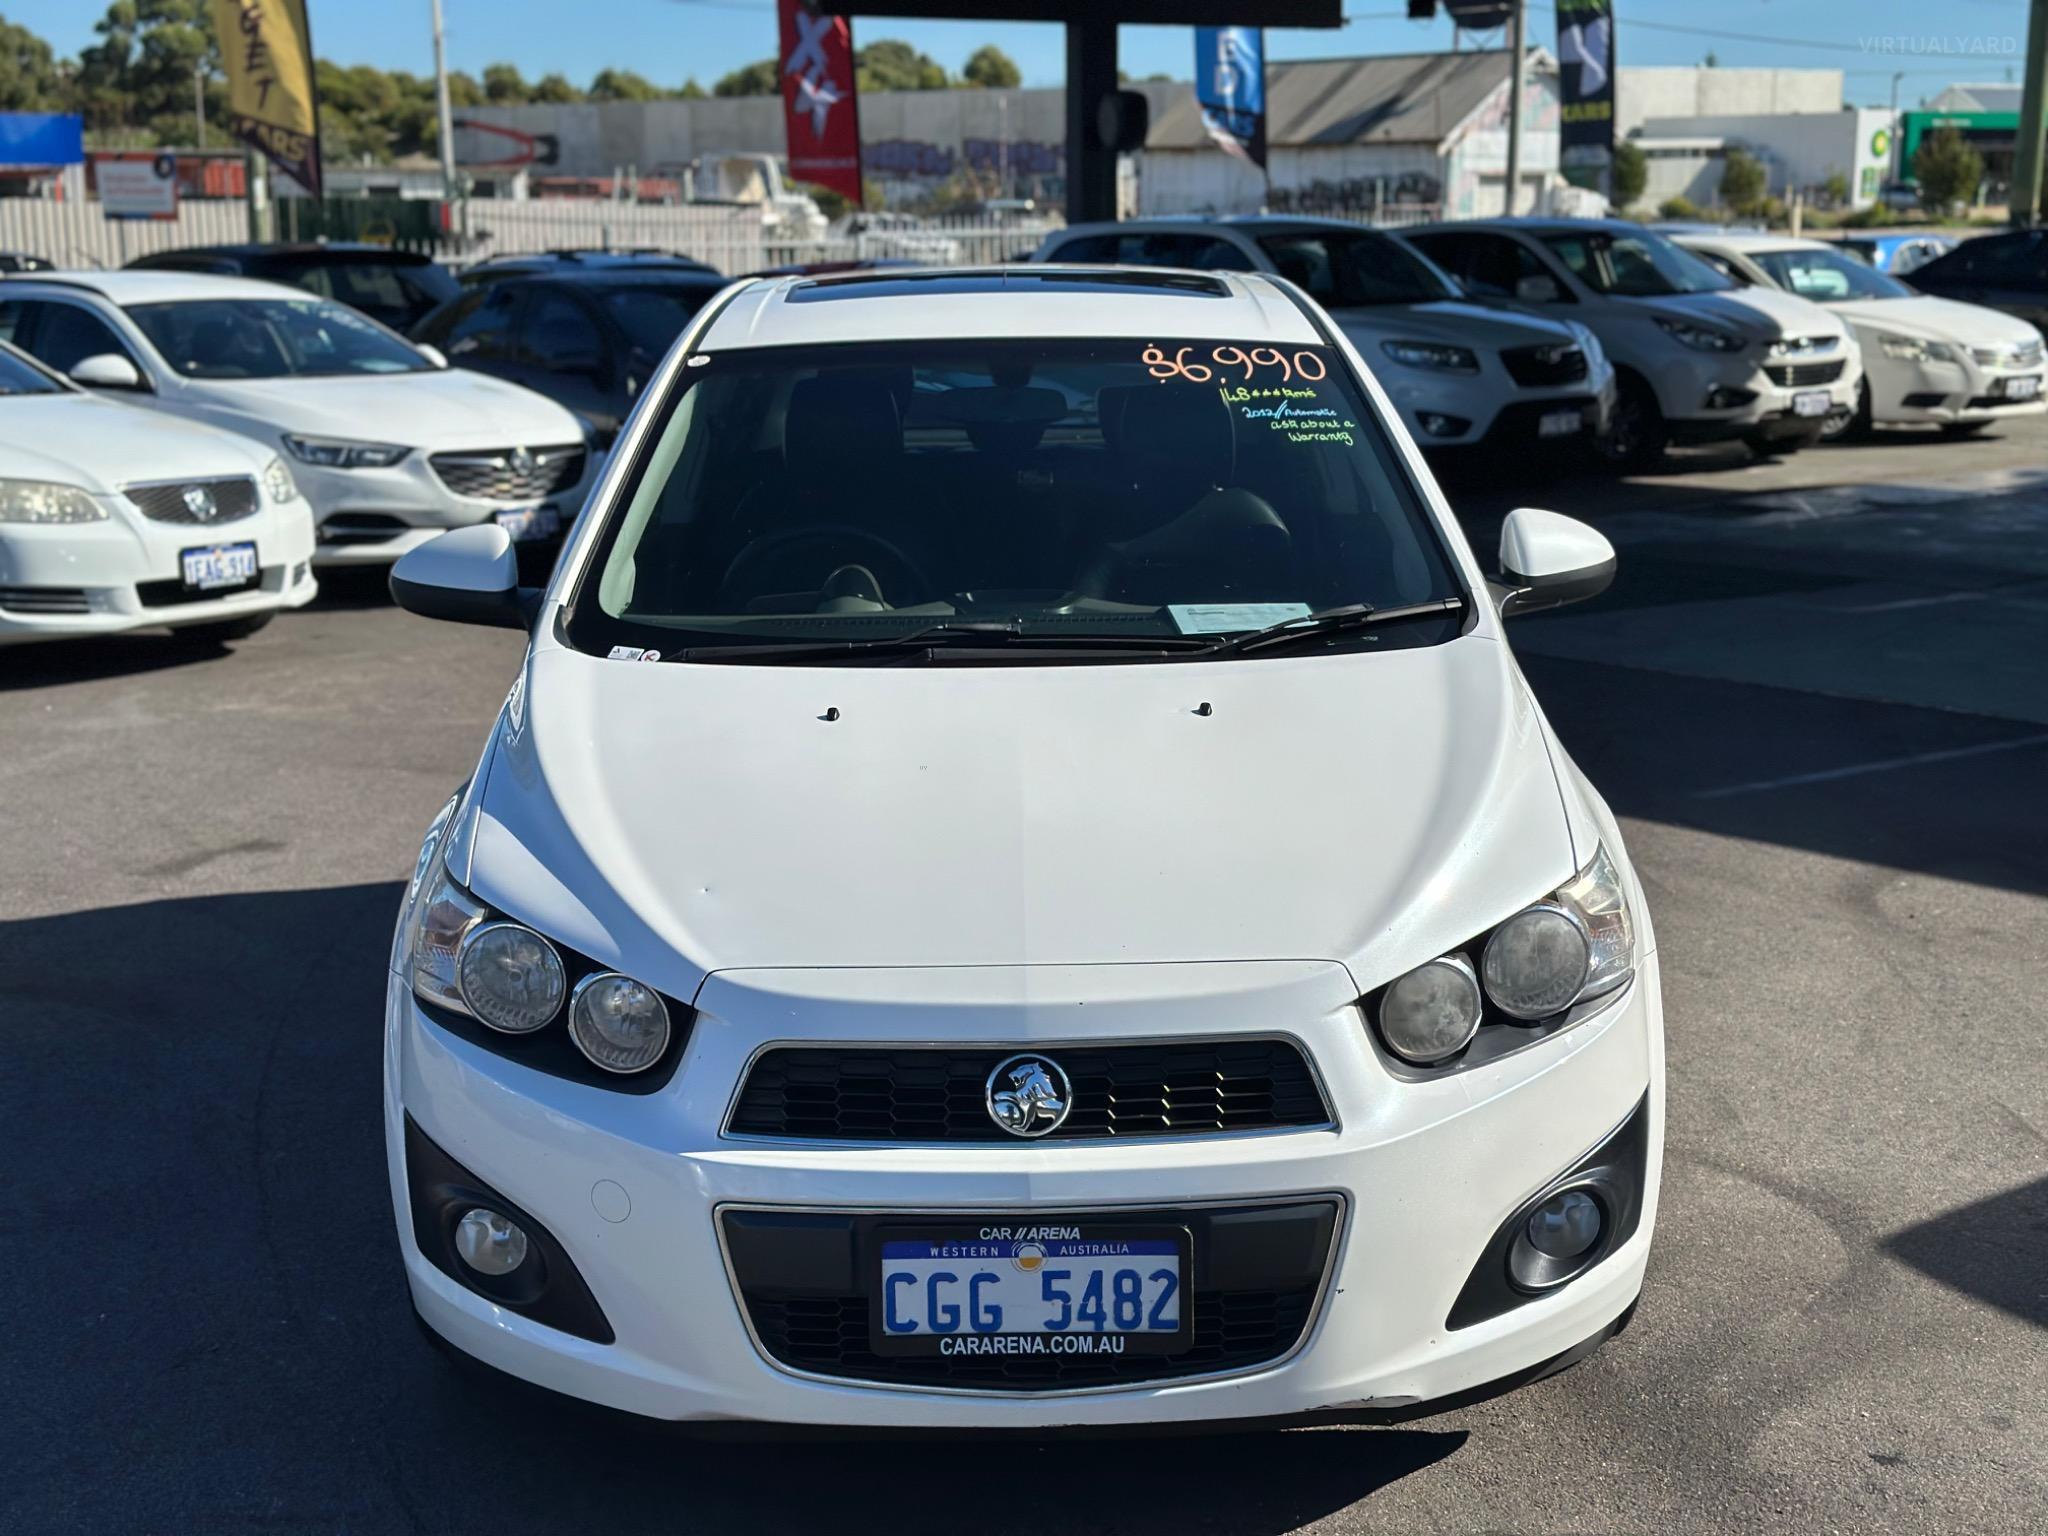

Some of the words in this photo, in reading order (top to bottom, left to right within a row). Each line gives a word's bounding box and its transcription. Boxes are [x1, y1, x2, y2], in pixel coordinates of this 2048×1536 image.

[232, 0, 274, 110] GET
[1270, 419, 1299, 429] ask
[1300, 419, 1340, 429] about
[1343, 420, 1355, 428] a
[929, 1246, 999, 1258] WESTERN
[1059, 1243, 1130, 1256] AUSTRALIA
[885, 1272, 1003, 1334] CGG
[1041, 1268, 1179, 1332] 5482
[939, 1336, 1125, 1356] CARARENA.COM.AU
